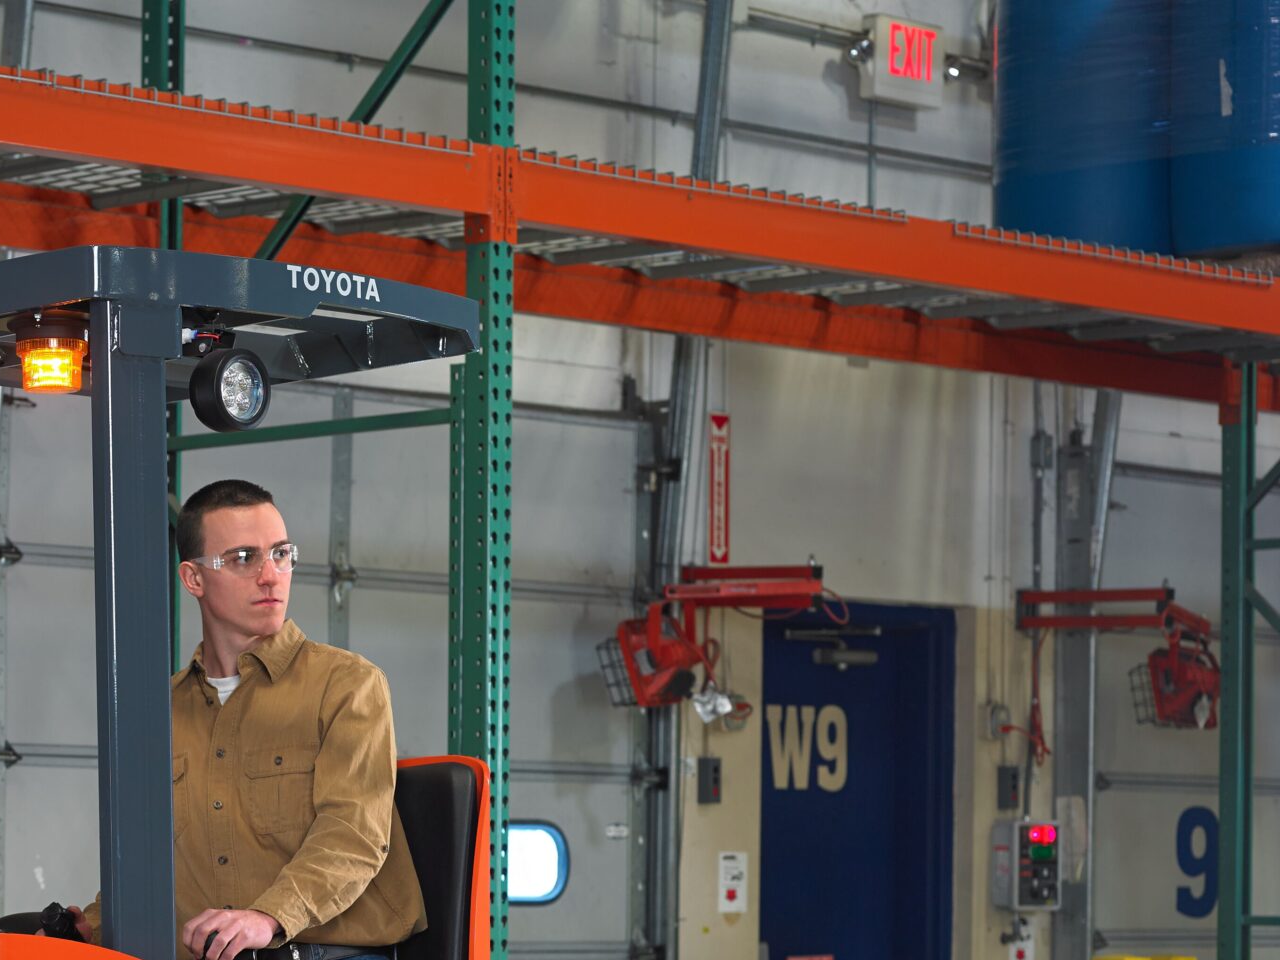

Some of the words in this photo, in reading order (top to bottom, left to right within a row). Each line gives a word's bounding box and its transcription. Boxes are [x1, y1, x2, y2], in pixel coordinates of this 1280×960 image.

[888, 21, 938, 85] EXIT
[286, 263, 381, 303] TOYOTA
[765, 704, 848, 792] W9
[1176, 804, 1220, 919] 9
